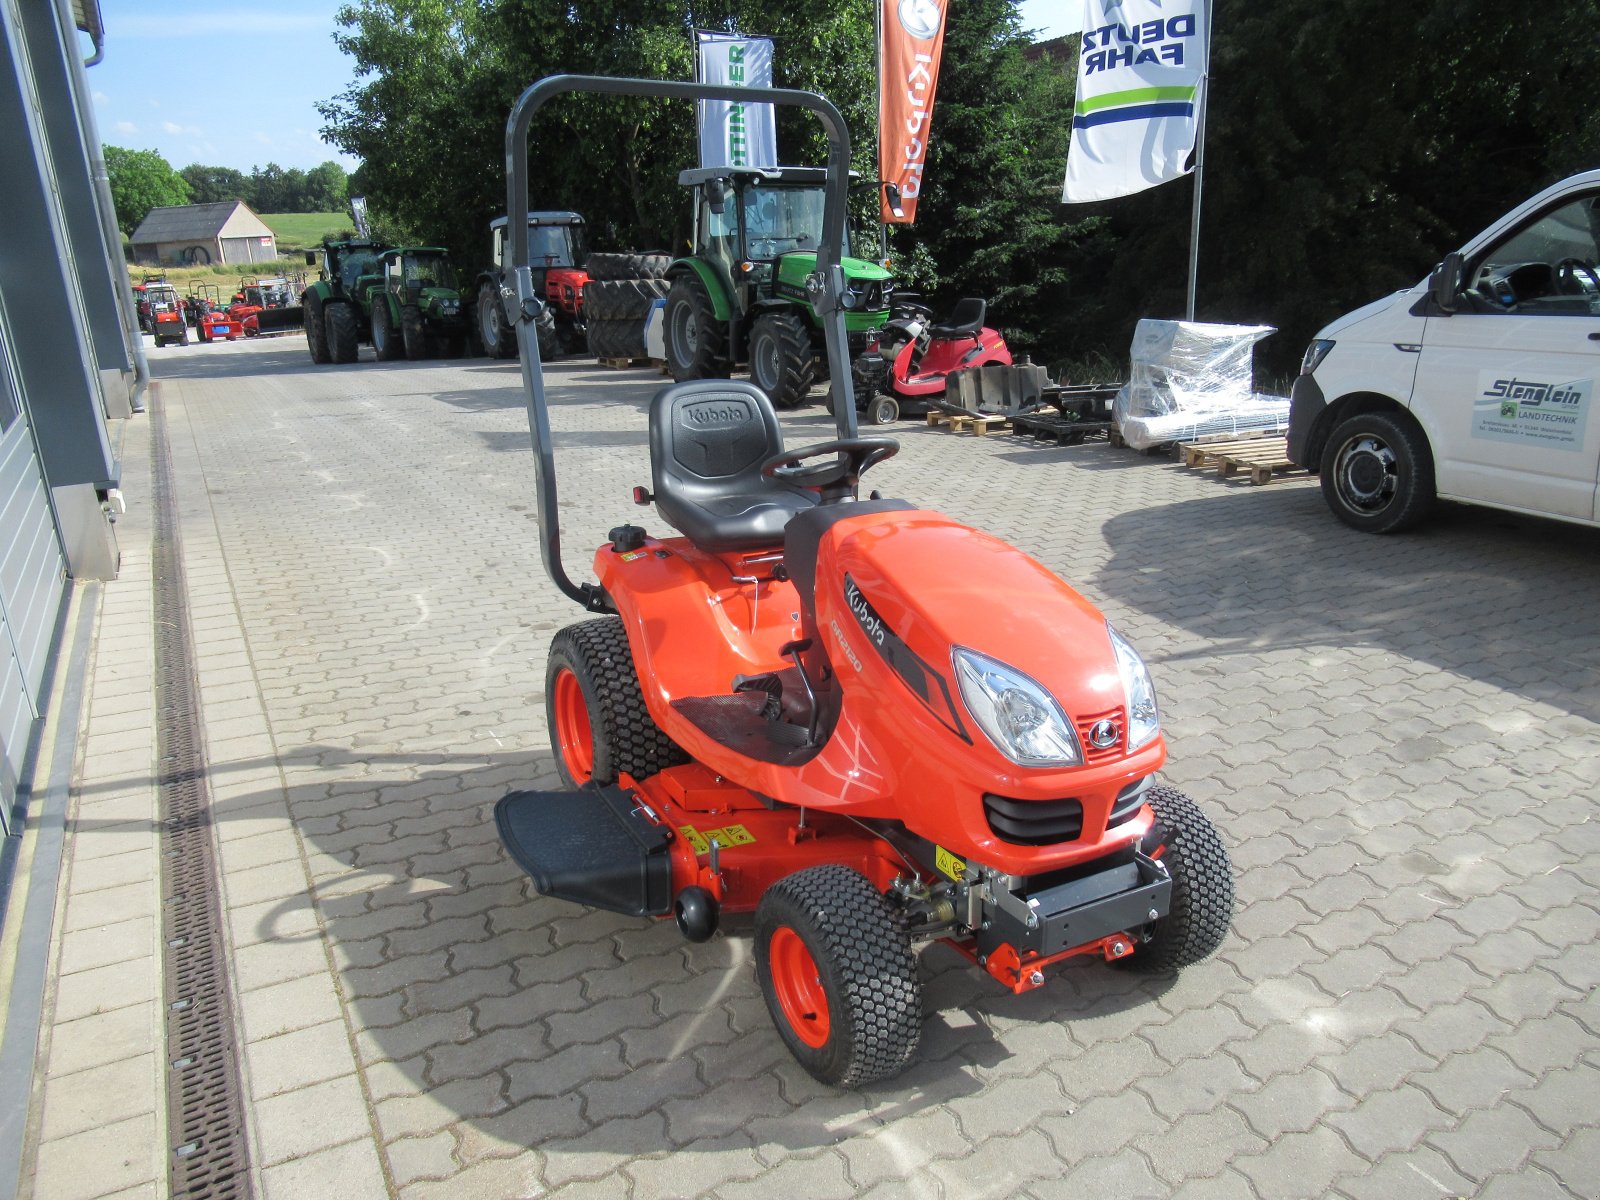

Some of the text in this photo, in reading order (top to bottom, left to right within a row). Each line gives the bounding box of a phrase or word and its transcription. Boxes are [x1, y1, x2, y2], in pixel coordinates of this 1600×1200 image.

[901, 53, 932, 199] Kubota
[1483, 377, 1582, 406] Stenglein
[688, 407, 743, 423] Kubota
[1518, 411, 1579, 424] LANDTECHNIK
[847, 584, 885, 646] Kubota
[831, 619, 863, 673] GR2120
